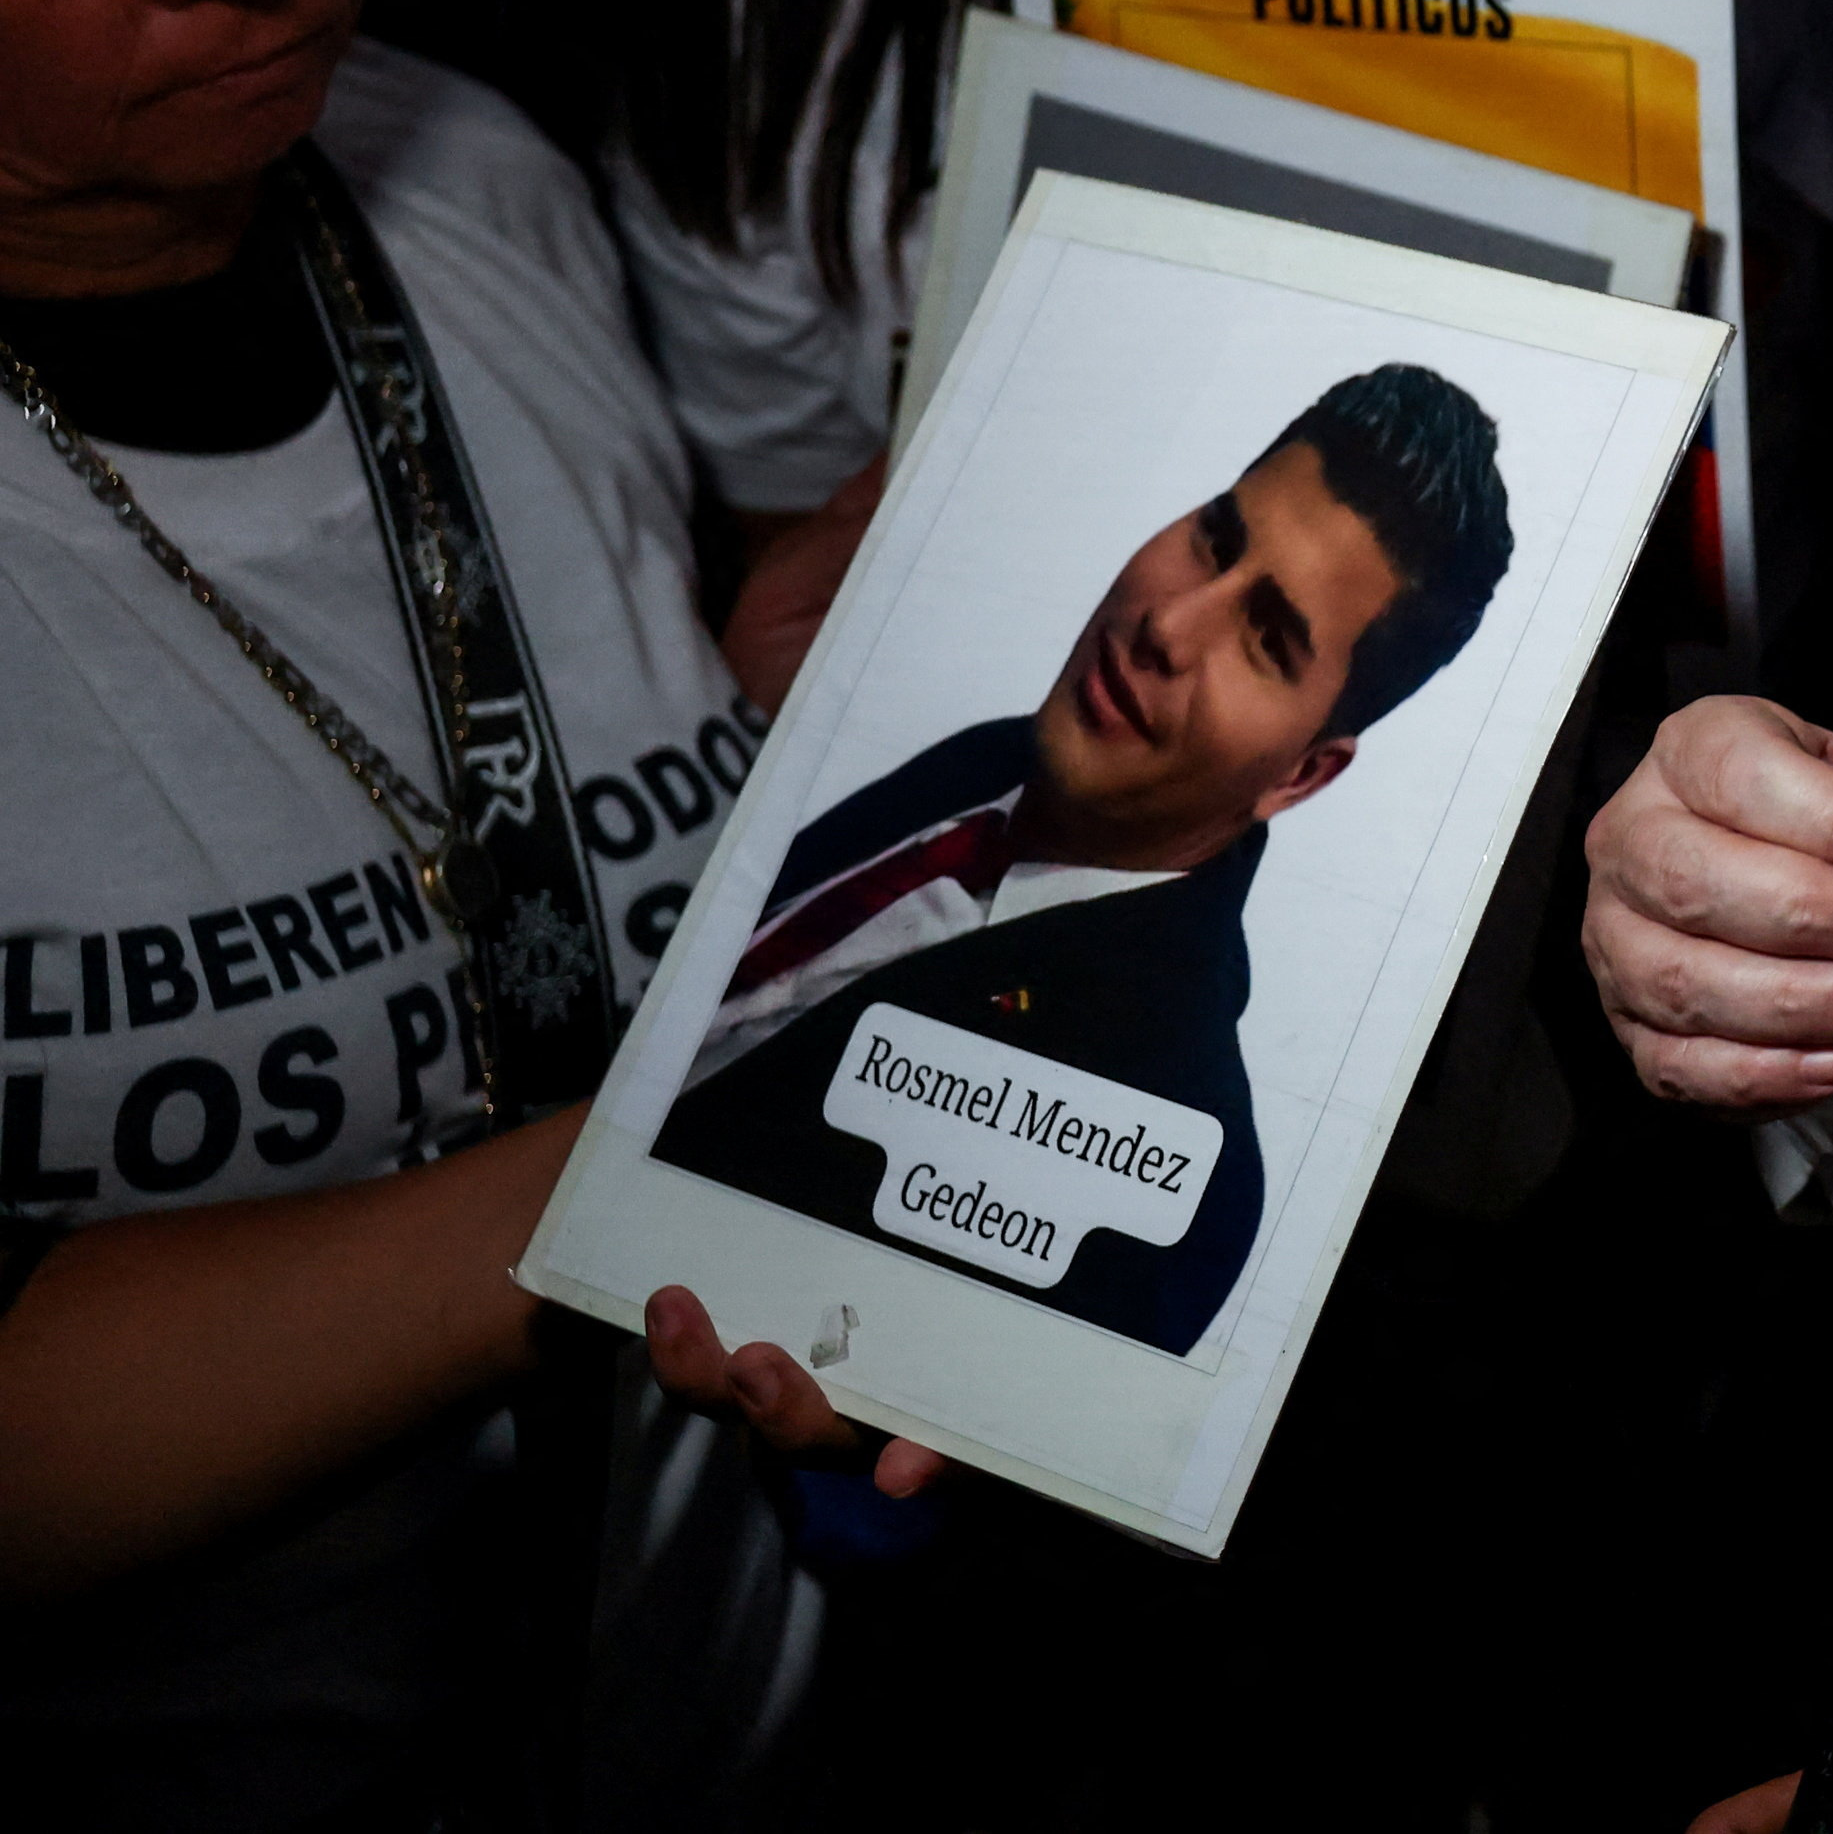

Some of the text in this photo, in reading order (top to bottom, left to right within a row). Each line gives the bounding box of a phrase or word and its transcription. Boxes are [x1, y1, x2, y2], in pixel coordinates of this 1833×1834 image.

[0, 853, 430, 1039] LIBEREN
[0, 1025, 346, 1202] LOS
[854, 1034, 1192, 1195] Rosmel Mendez
[901, 1163, 1058, 1261] Gedeon
